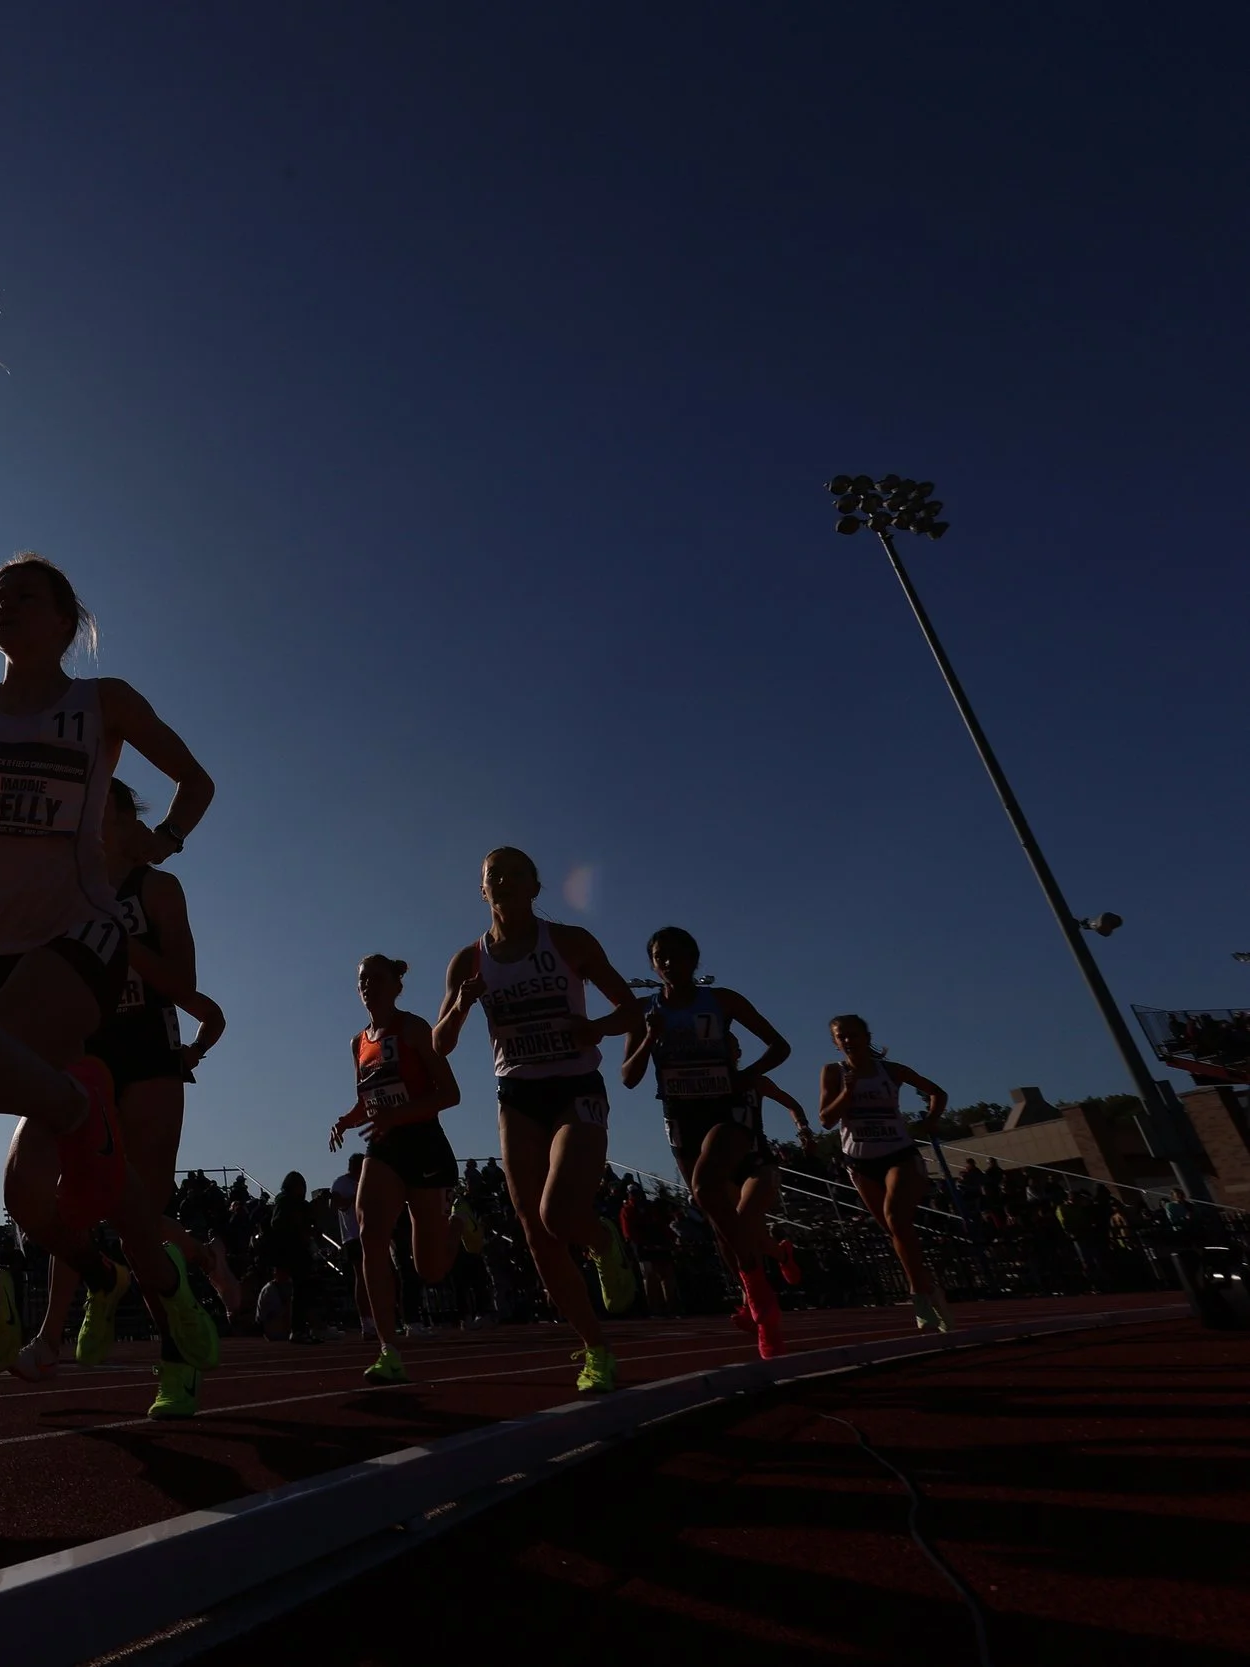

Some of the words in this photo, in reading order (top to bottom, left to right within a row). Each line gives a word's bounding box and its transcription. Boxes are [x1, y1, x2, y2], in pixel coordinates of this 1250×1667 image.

[53, 711, 84, 741] 11
[1, 777, 48, 794] MADDIE
[121, 900, 140, 933] 3
[528, 950, 556, 973] 10
[482, 975, 569, 1008] GENESEO
[697, 1014, 711, 1039] 7
[384, 1037, 393, 1061] 5
[582, 1098, 603, 1124] 10
